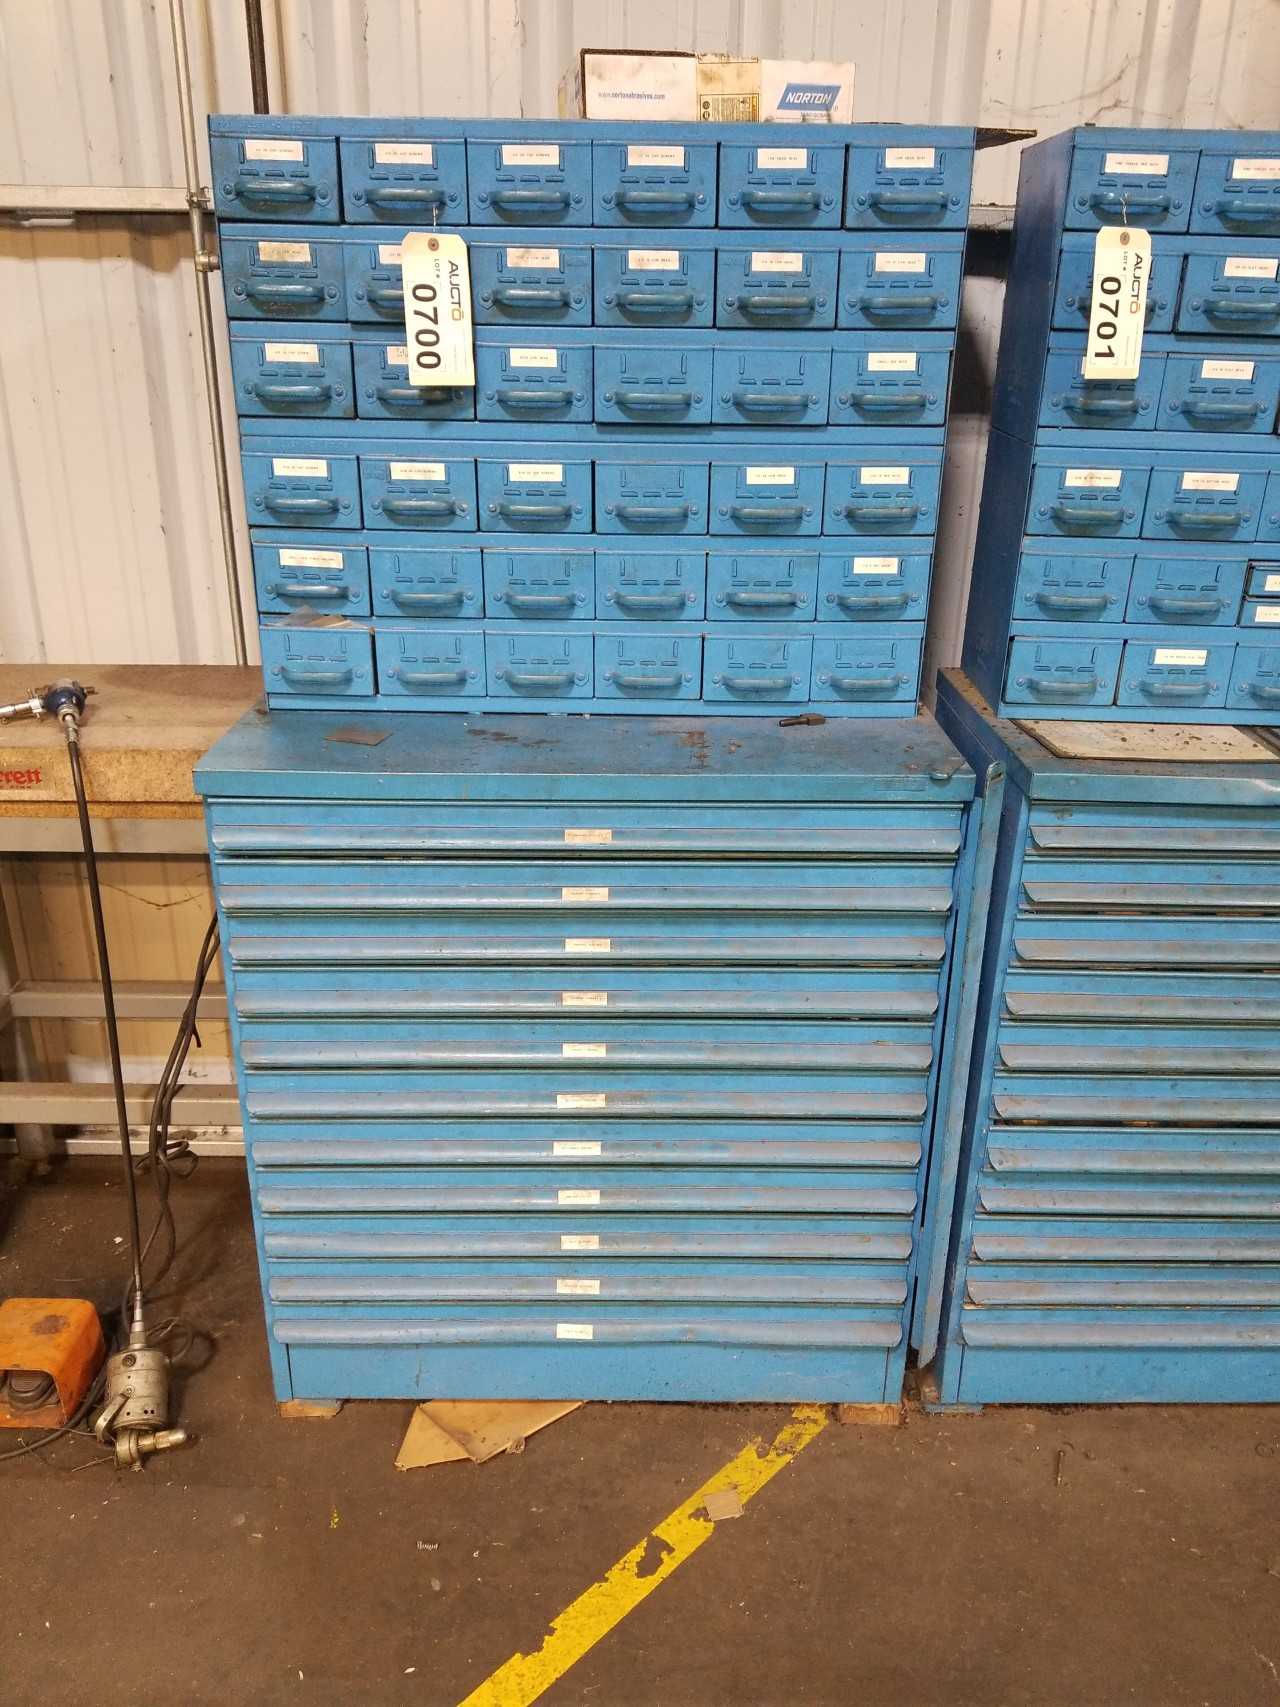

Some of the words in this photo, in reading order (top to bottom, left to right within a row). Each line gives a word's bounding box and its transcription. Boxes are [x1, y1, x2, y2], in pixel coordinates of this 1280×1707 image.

[785, 92, 832, 104] NORTON
[412, 284, 441, 369] 0700
[1094, 276, 1122, 358] 0701
